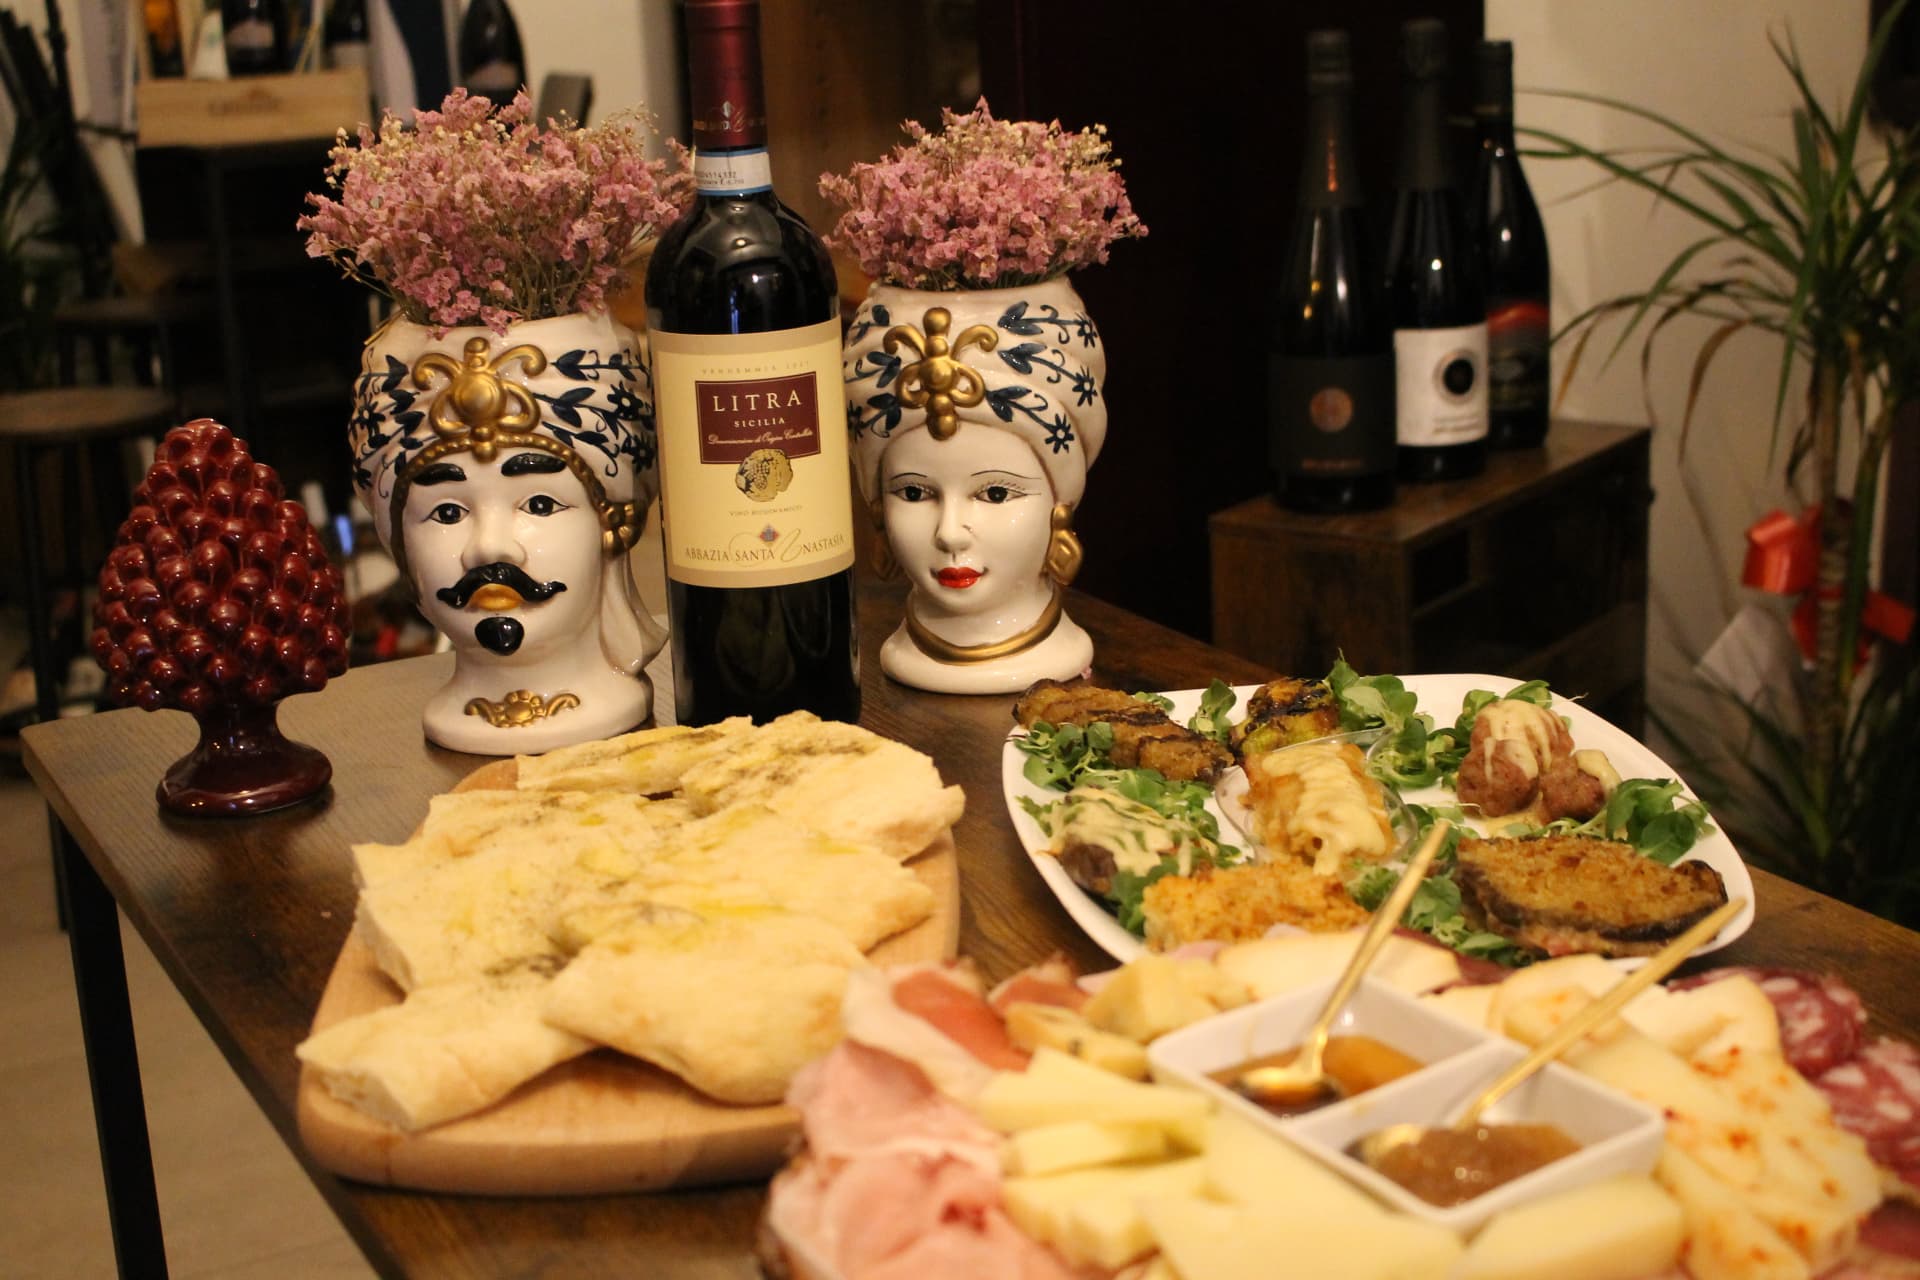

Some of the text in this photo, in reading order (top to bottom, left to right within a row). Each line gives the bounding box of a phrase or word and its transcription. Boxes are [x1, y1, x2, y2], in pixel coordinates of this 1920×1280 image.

[713, 390, 802, 412] LITRA
[734, 417, 785, 427] SICILIA
[685, 547, 730, 562] ABBAZIA
[735, 549, 775, 562] SANTA
